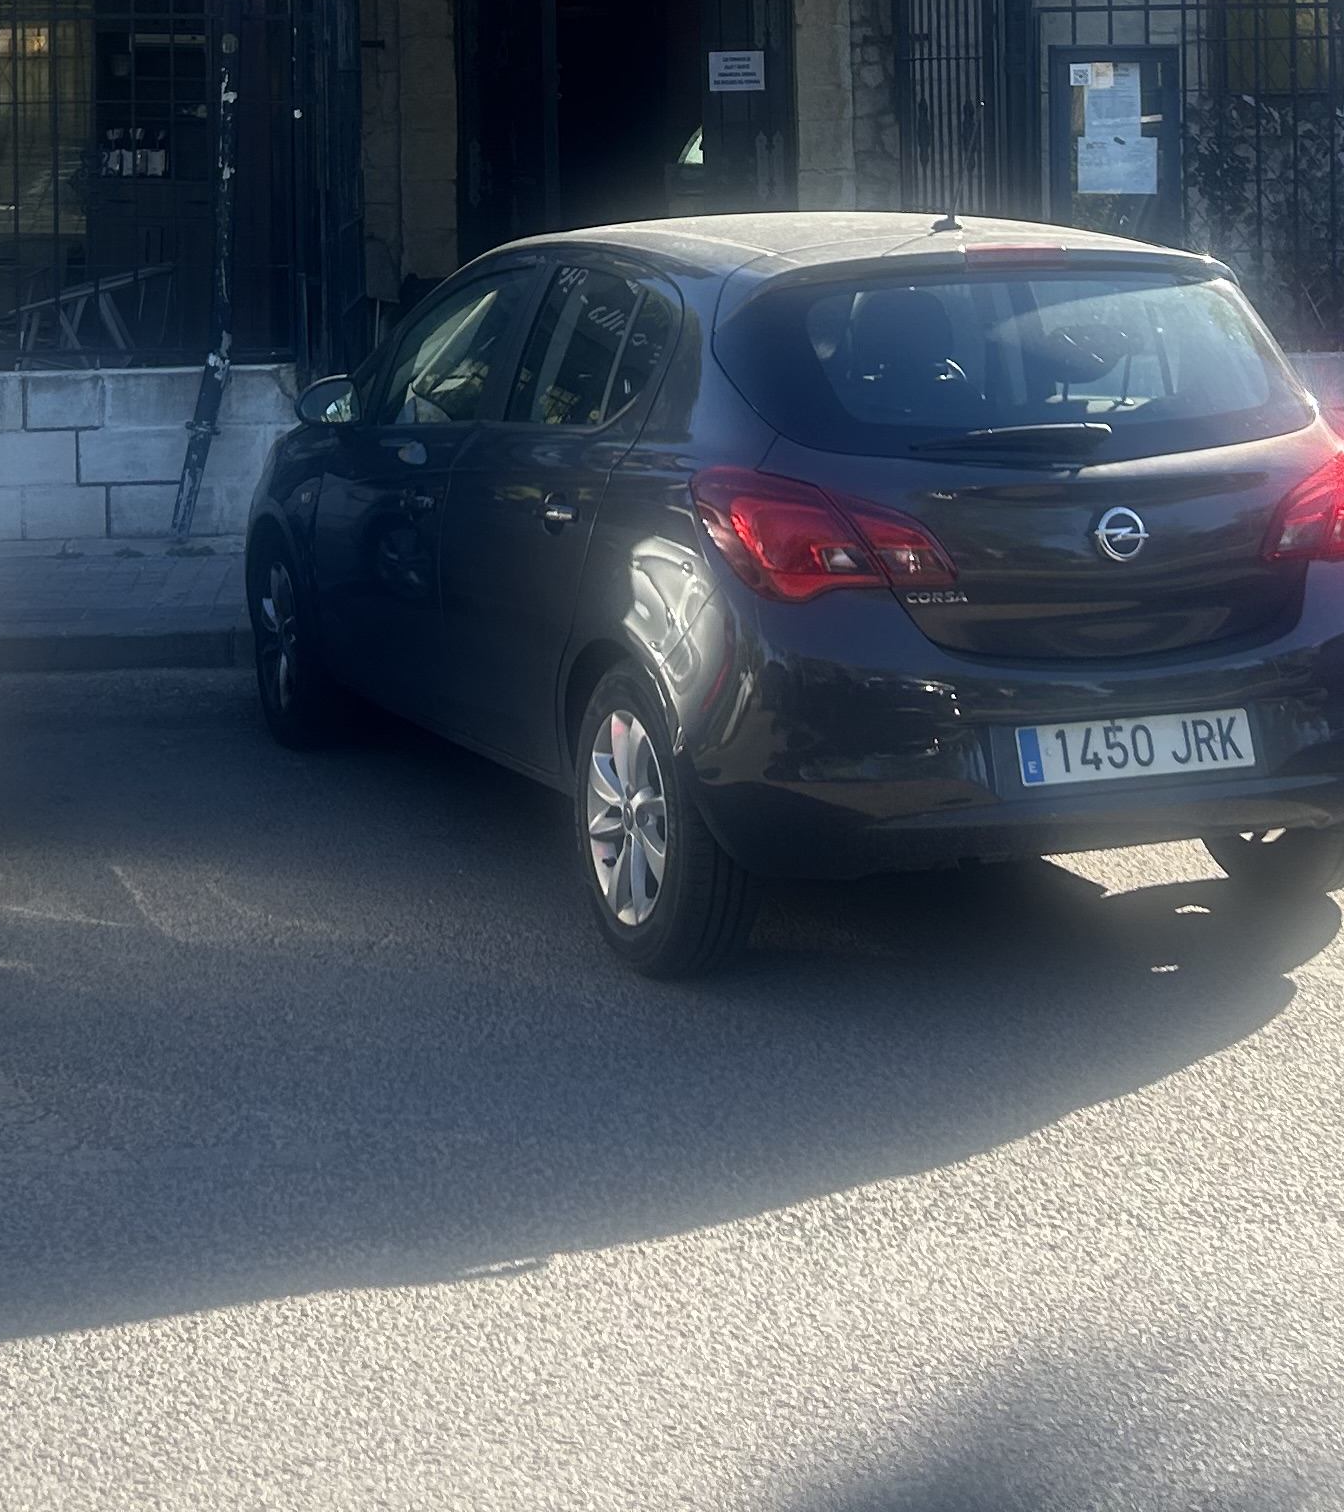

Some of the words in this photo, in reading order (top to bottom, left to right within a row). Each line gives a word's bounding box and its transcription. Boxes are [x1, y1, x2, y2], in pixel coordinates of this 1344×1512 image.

[906, 591, 968, 604] CORSA
[1027, 761, 1038, 774] E
[1055, 723, 1155, 774] 1450
[1171, 716, 1245, 765] JRK
